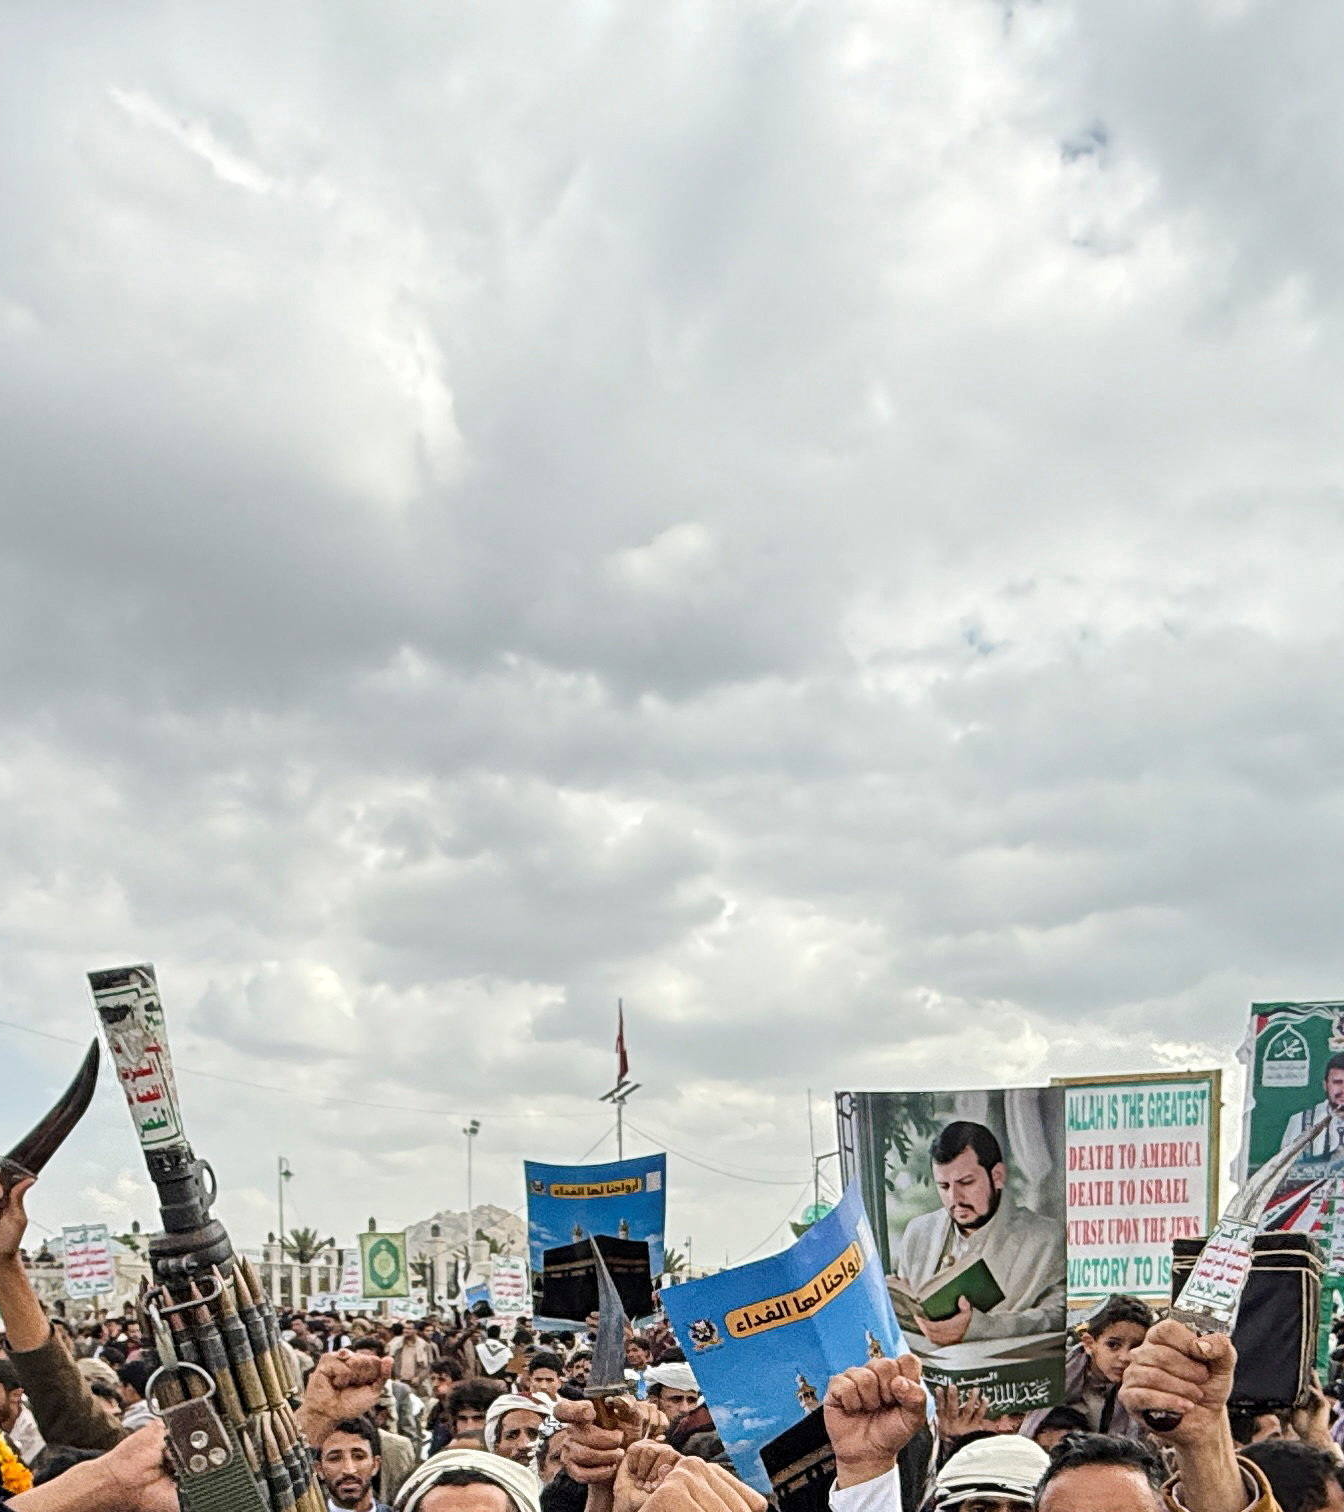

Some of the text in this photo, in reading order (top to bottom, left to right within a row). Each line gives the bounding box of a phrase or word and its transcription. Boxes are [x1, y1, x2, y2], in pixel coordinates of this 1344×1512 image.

[1068, 1090, 1206, 1131] ALLAH IS THE GREATEST
[1069, 1141, 1202, 1171] DEATH TO AMERICA
[1069, 1178, 1190, 1207] DEATH TO ISRAEL
[1068, 1216, 1200, 1246] CURSE UPON THE JEWS
[1068, 1256, 1129, 1287] VICTORY
[1134, 1256, 1153, 1285] TO
[793, 1285, 823, 1313] لها
[736, 1300, 792, 1333] الفداء
[957, 1371, 997, 1387] السيد
